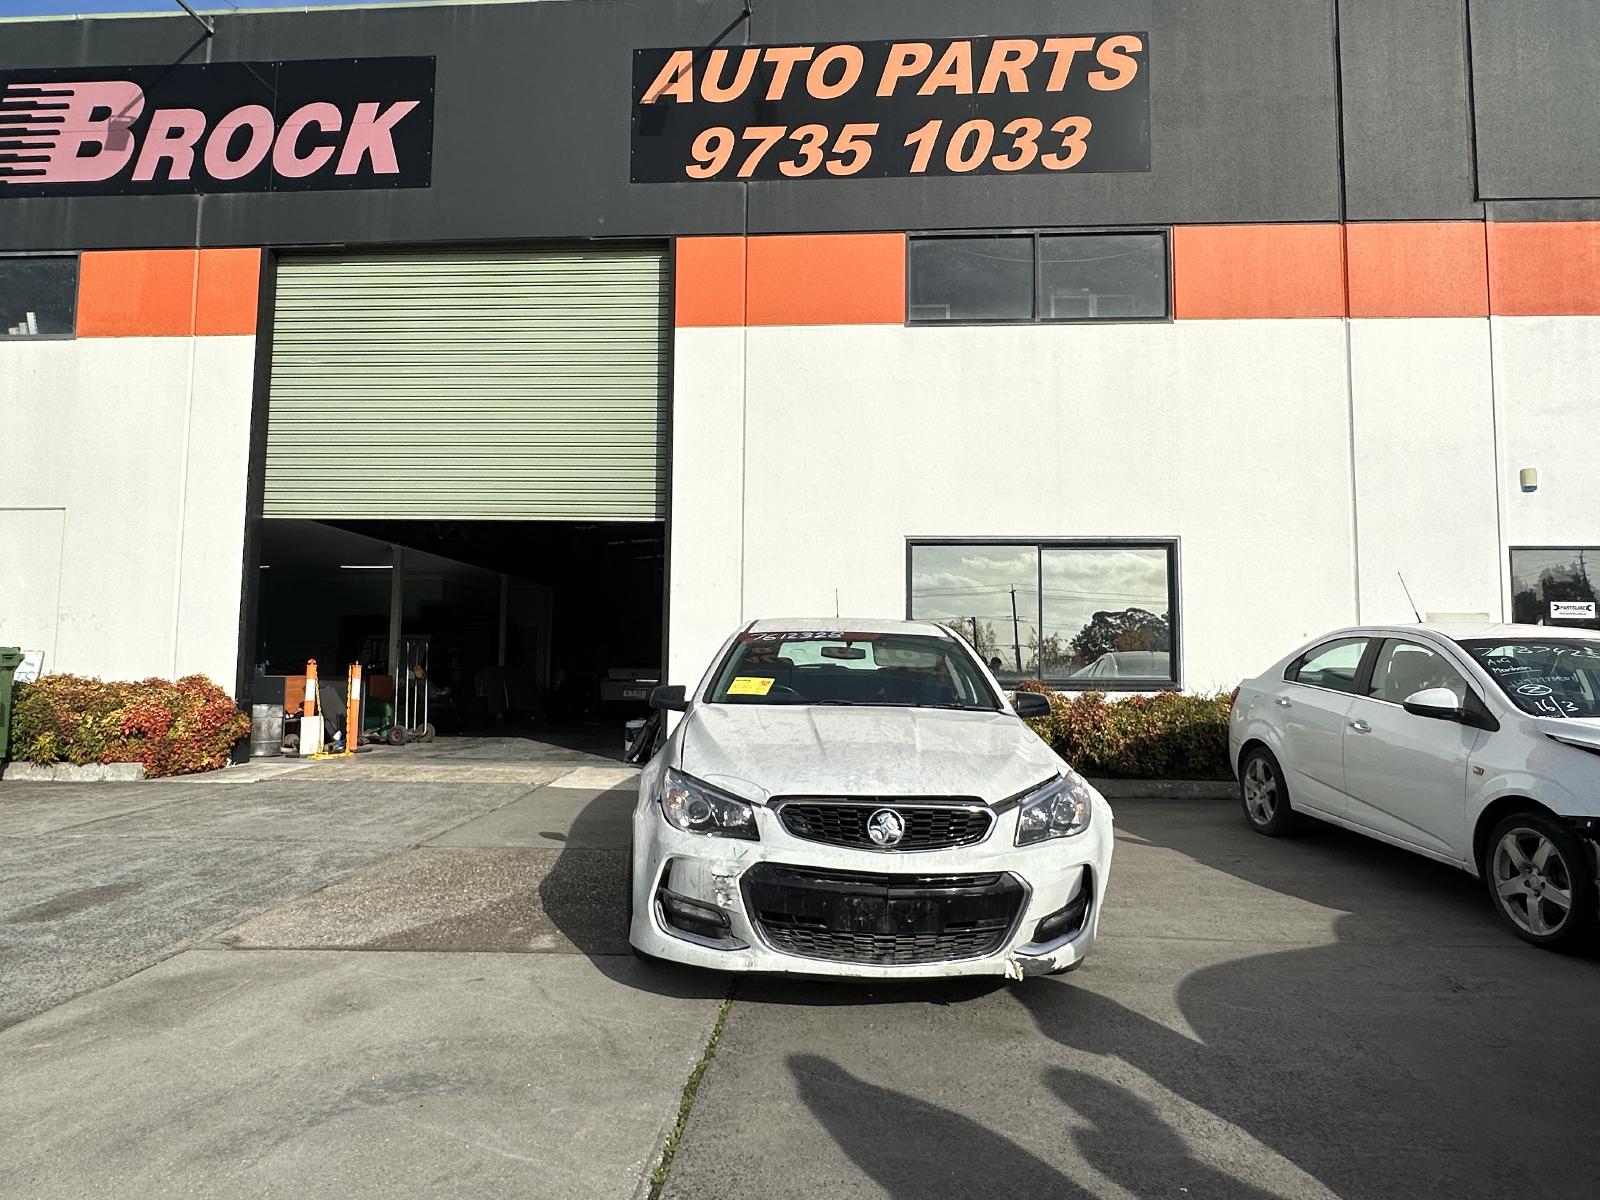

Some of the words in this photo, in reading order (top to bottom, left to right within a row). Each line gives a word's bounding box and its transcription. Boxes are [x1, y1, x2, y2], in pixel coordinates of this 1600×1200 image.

[640, 46, 864, 104] AUTO
[876, 35, 1142, 97] PARTS
[0, 80, 420, 184] BROCK
[685, 122, 879, 179] 9735
[904, 116, 1093, 174] 1033
